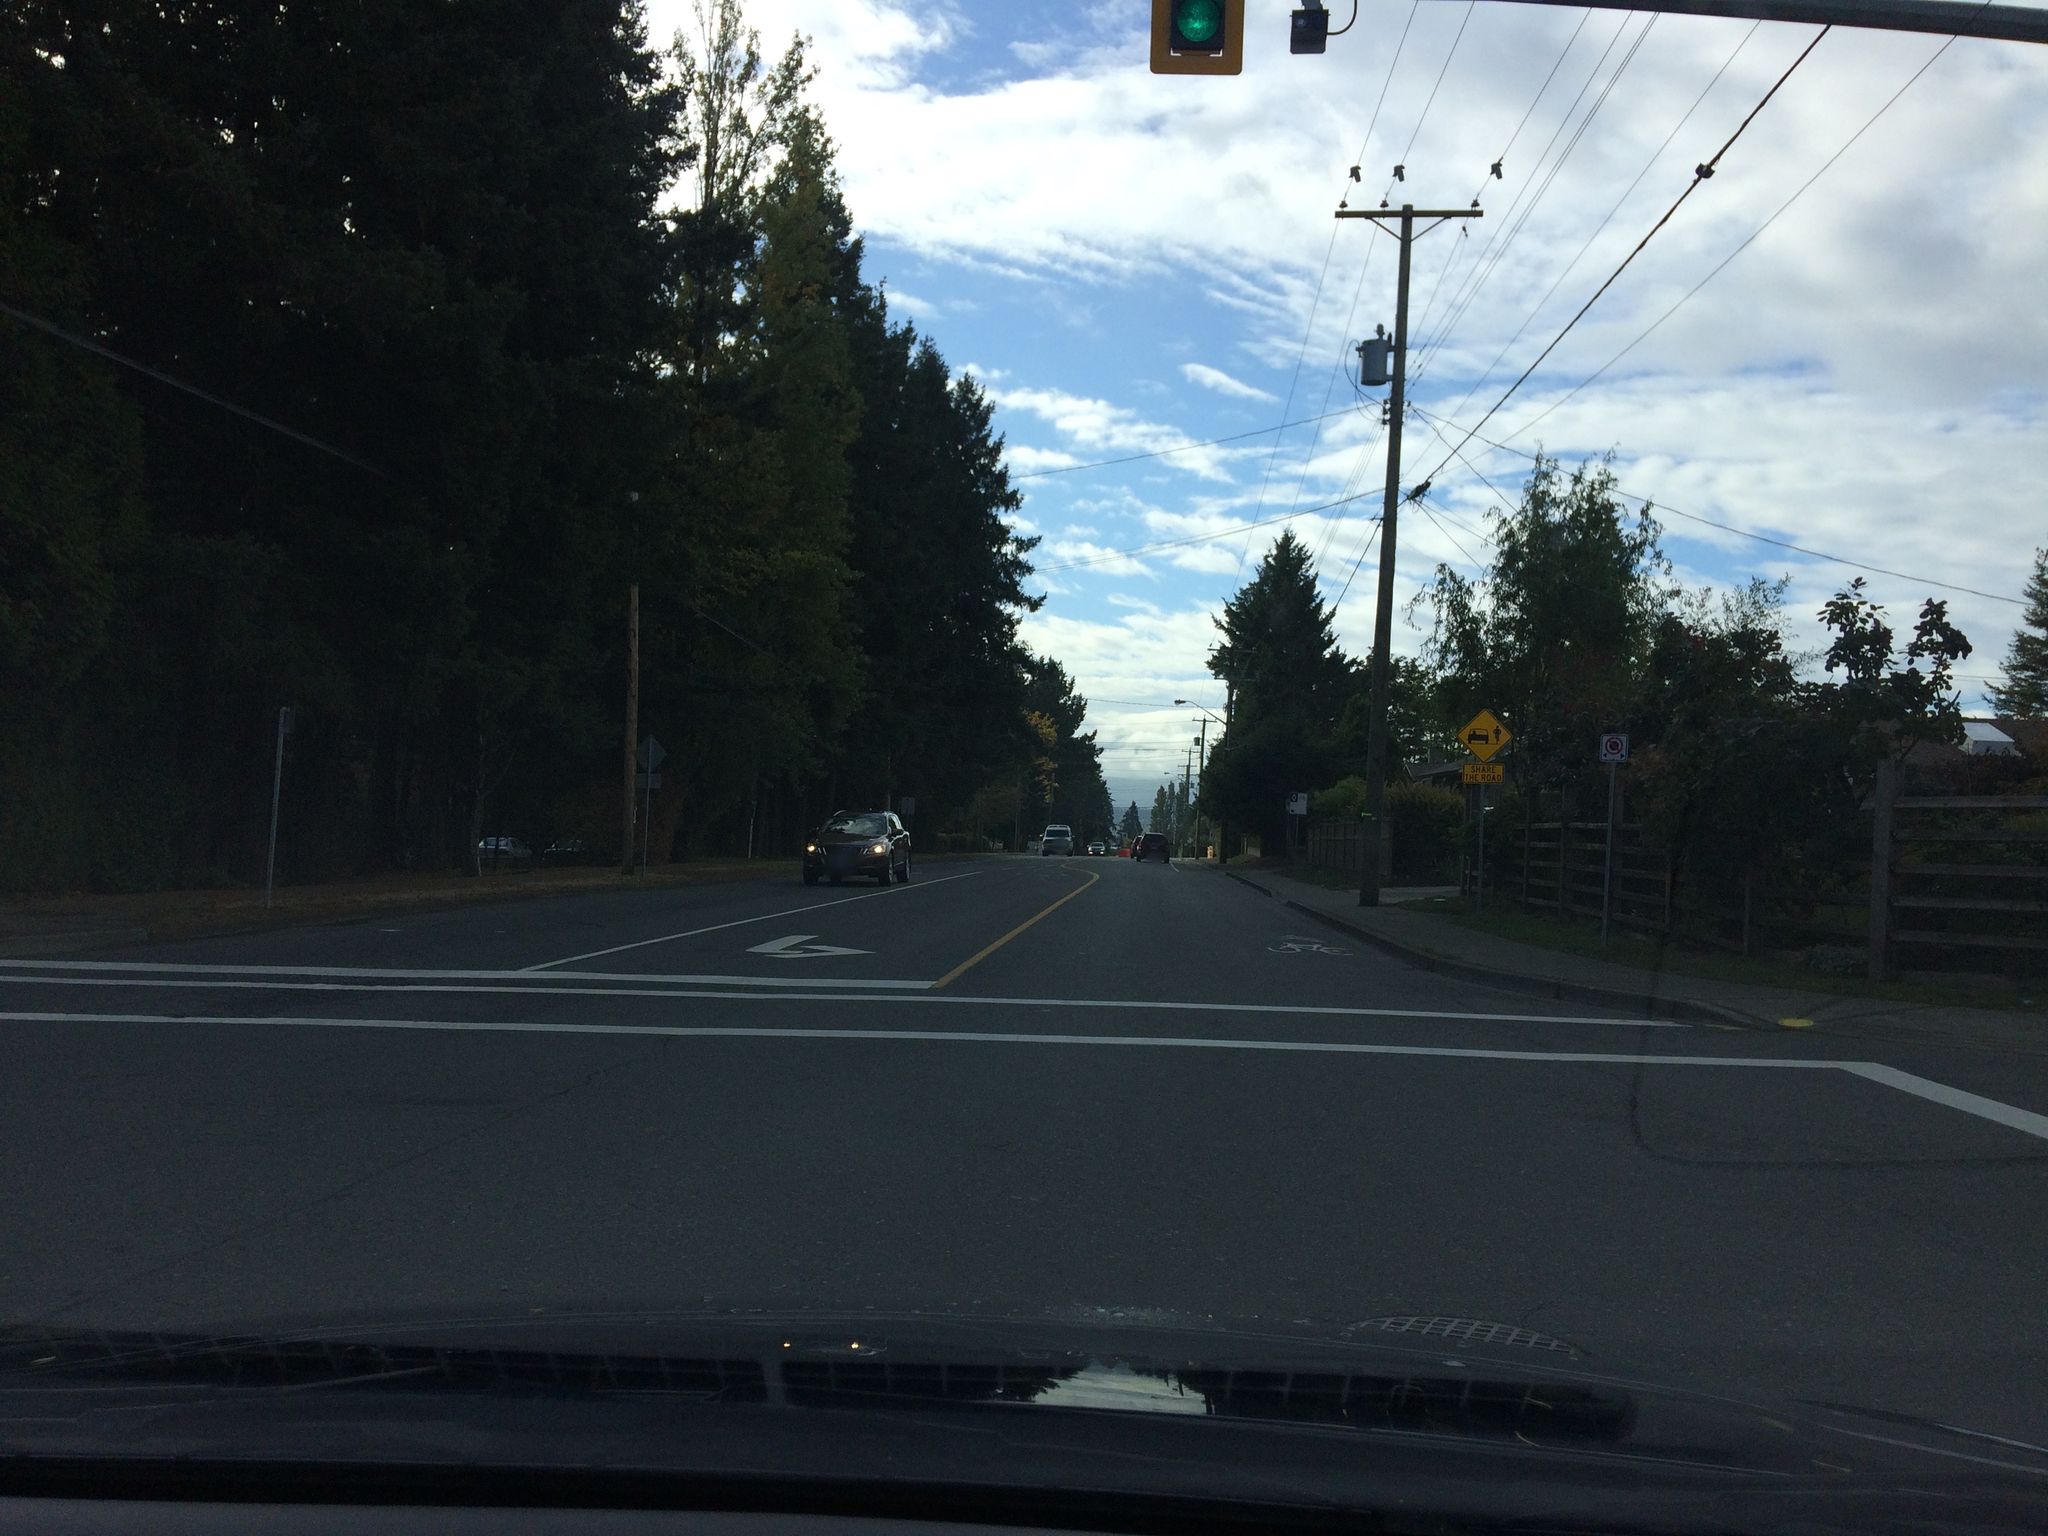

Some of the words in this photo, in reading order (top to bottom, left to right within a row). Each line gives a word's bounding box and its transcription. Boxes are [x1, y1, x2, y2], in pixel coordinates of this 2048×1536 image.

[1471, 765, 1496, 773] SHARE
[1465, 773, 1479, 781] THE
[1481, 774, 1502, 782] ROAD
